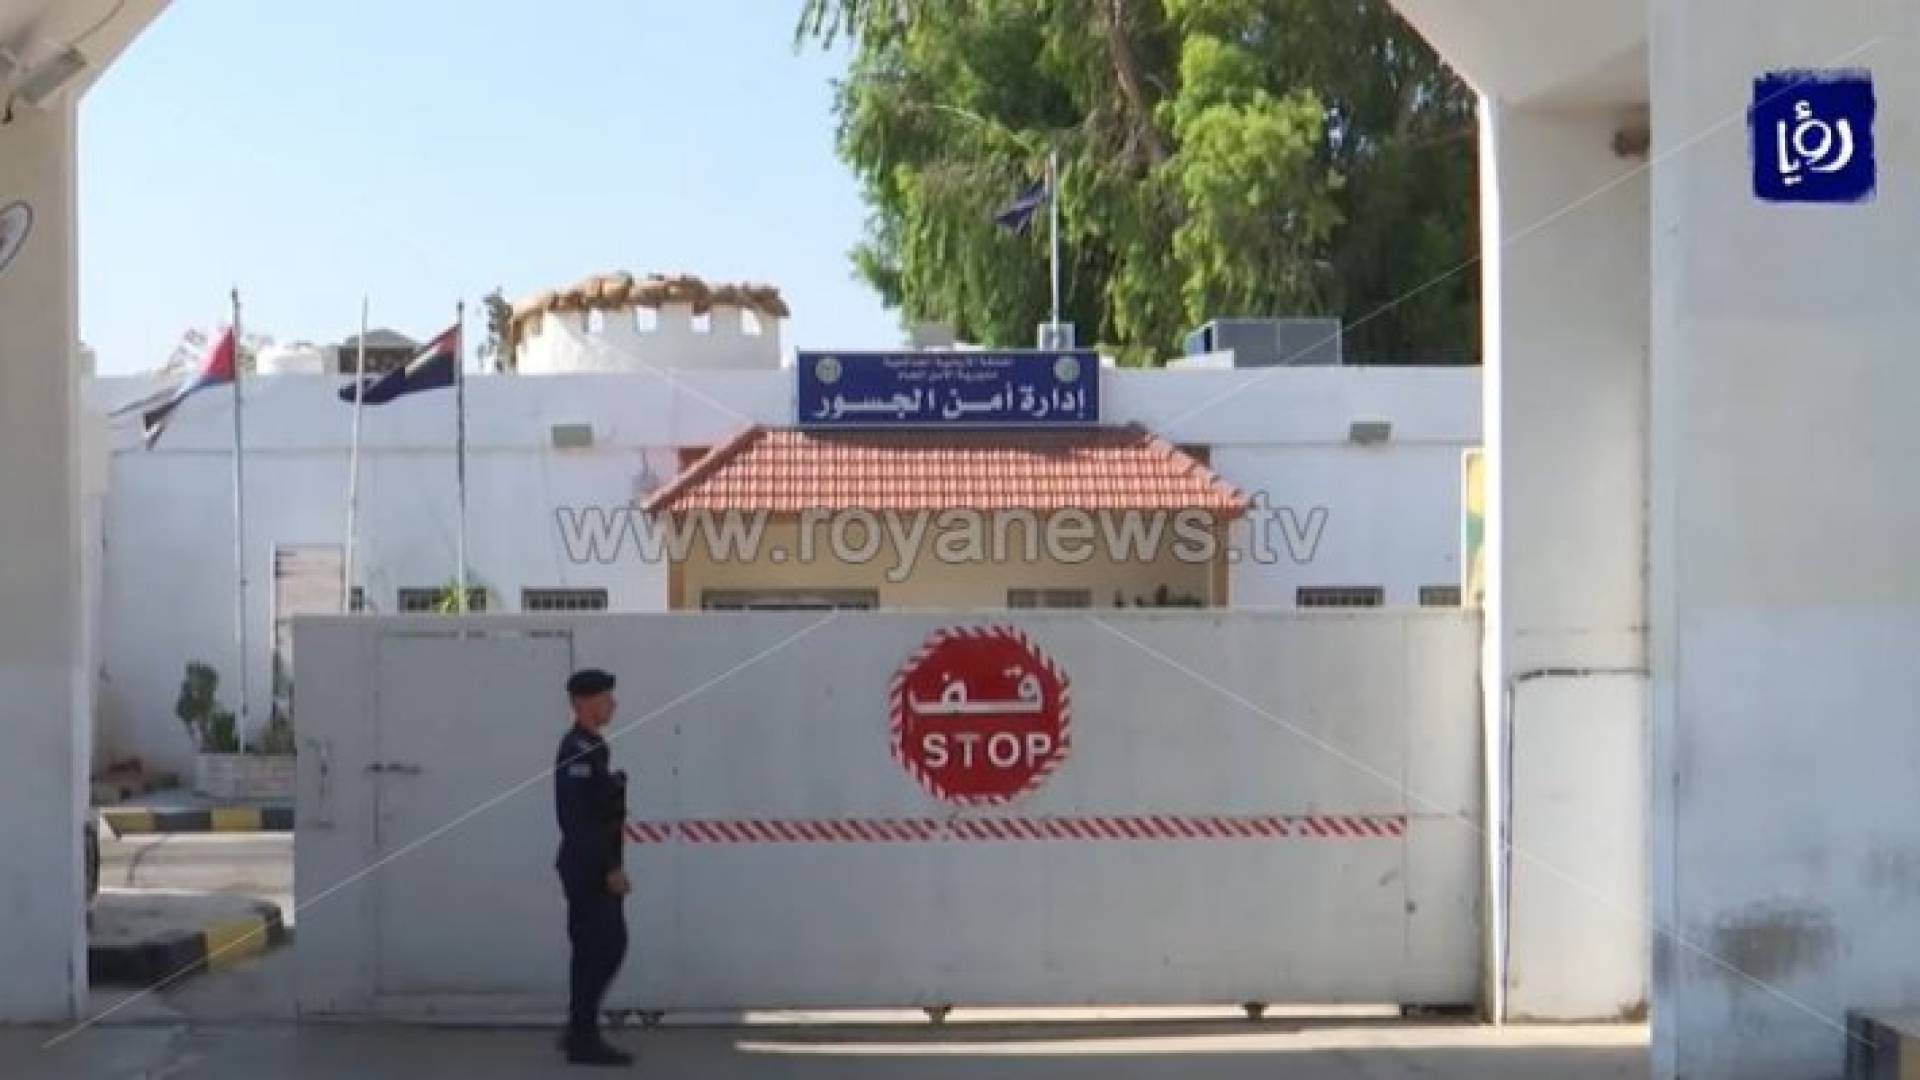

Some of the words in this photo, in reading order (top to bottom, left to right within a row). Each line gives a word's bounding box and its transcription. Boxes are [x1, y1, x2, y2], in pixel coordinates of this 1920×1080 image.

[814, 387, 935, 419] الجسور
[1018, 385, 1084, 419] إدارة
[908, 664, 1043, 714] قف
[922, 731, 1052, 768] STOP
